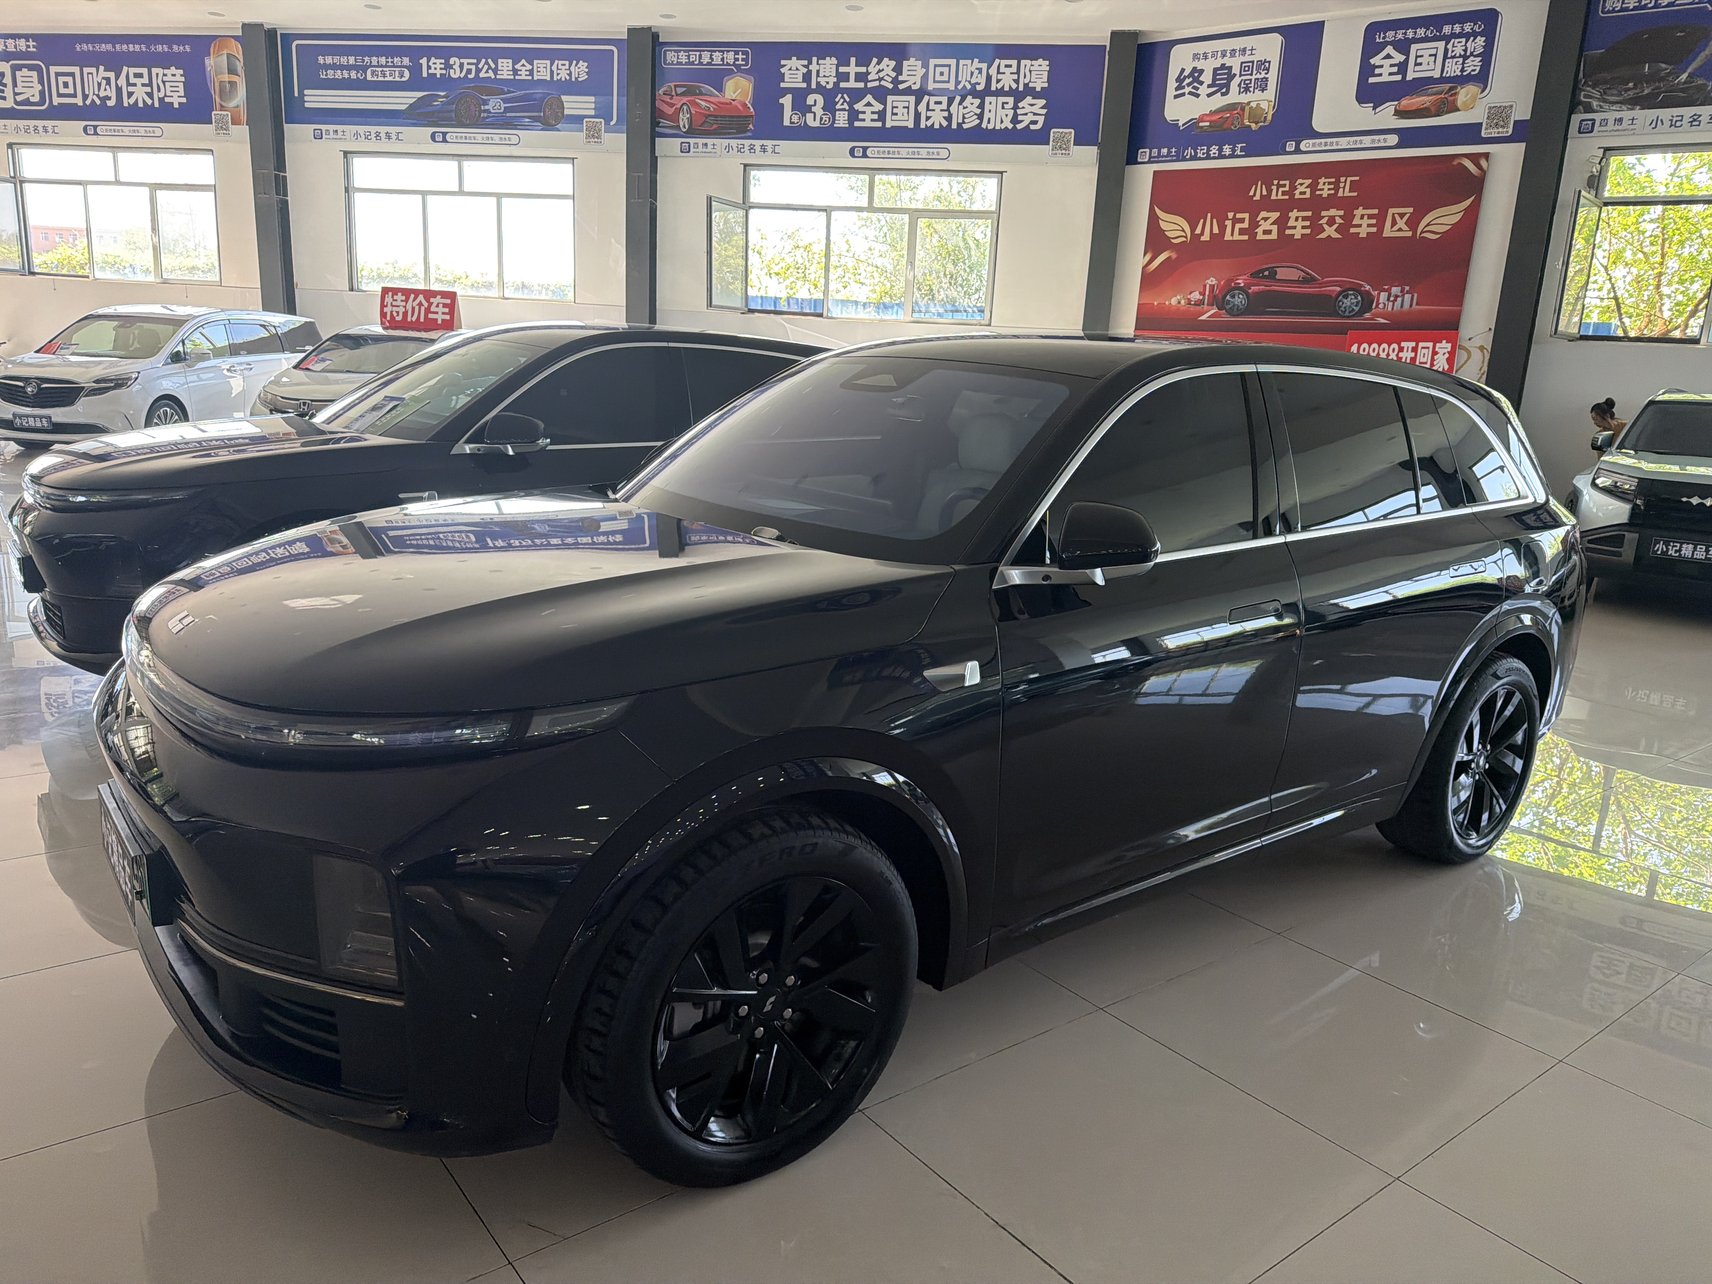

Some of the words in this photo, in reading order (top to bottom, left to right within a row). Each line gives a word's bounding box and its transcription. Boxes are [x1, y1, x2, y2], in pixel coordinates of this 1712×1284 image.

[1375, 21, 1485, 42] 让您买车放心、用车安心
[1191, 46, 1257, 62] 购车可享查博士
[1446, 36, 1487, 57] 保修
[666, 50, 747, 65] 购车可享查博士
[1367, 40, 1446, 83] 全国
[1442, 57, 1483, 77] 服务
[370, 69, 406, 79] 购车可享
[780, 56, 1050, 91] 查博士终身回购保障
[1238, 58, 1271, 77] 回购
[1173, 63, 1237, 99] 终身
[1237, 77, 1269, 95] 保障
[13, 124, 60, 135] 小记名车汇
[353, 130, 404, 141] 小记名车汇
[724, 142, 781, 155] 小记名车汇
[1183, 143, 1247, 159] 小记名车汇
[1249, 176, 1360, 200] 小记名车汇
[1194, 206, 1414, 242] 小记名车交车区
[383, 291, 452, 325] 特价车
[15, 416, 49, 428] 小记精品车
